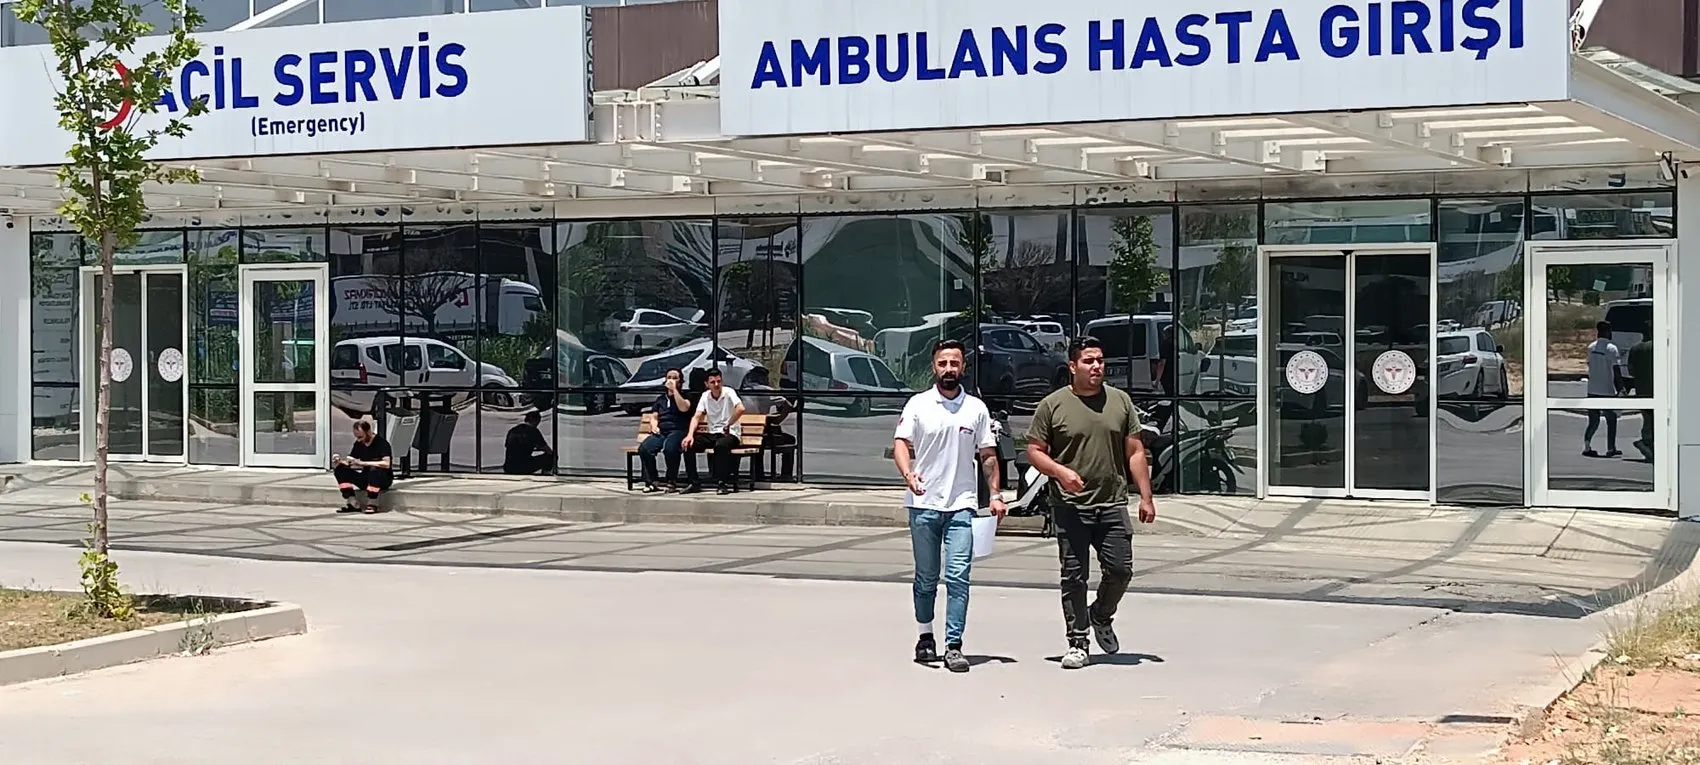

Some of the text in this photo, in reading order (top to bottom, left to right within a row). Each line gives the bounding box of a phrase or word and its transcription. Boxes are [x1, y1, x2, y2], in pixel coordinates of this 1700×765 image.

[275, 31, 468, 109] SERVİS
[752, 25, 1067, 88] AMBULANS
[1090, 10, 1298, 70] HASTA
[251, 111, 365, 137] (Emergency)
